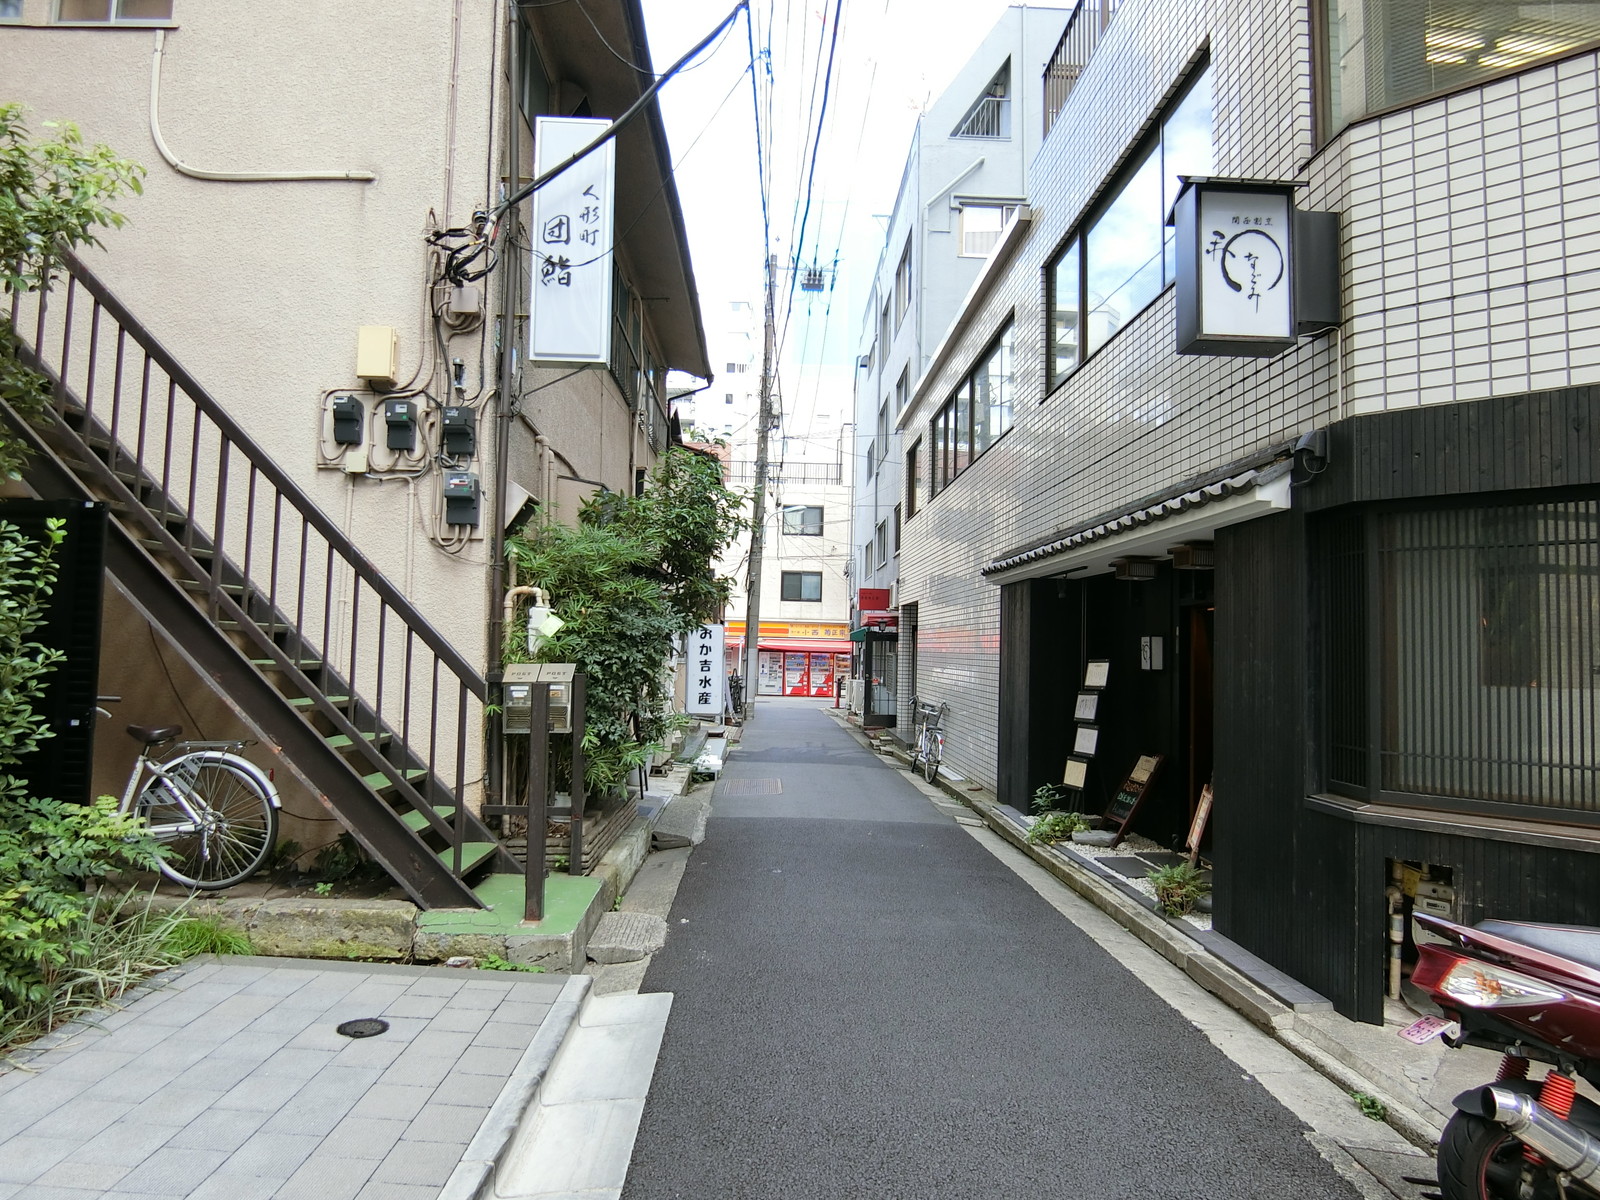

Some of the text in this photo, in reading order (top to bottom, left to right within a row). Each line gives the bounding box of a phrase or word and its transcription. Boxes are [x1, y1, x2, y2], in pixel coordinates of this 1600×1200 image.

[579, 184, 600, 247] 人形町
[540, 214, 572, 287] 団鮨
[1244, 252, 1262, 314] なごみ
[698, 628, 713, 705] おか吉水産
